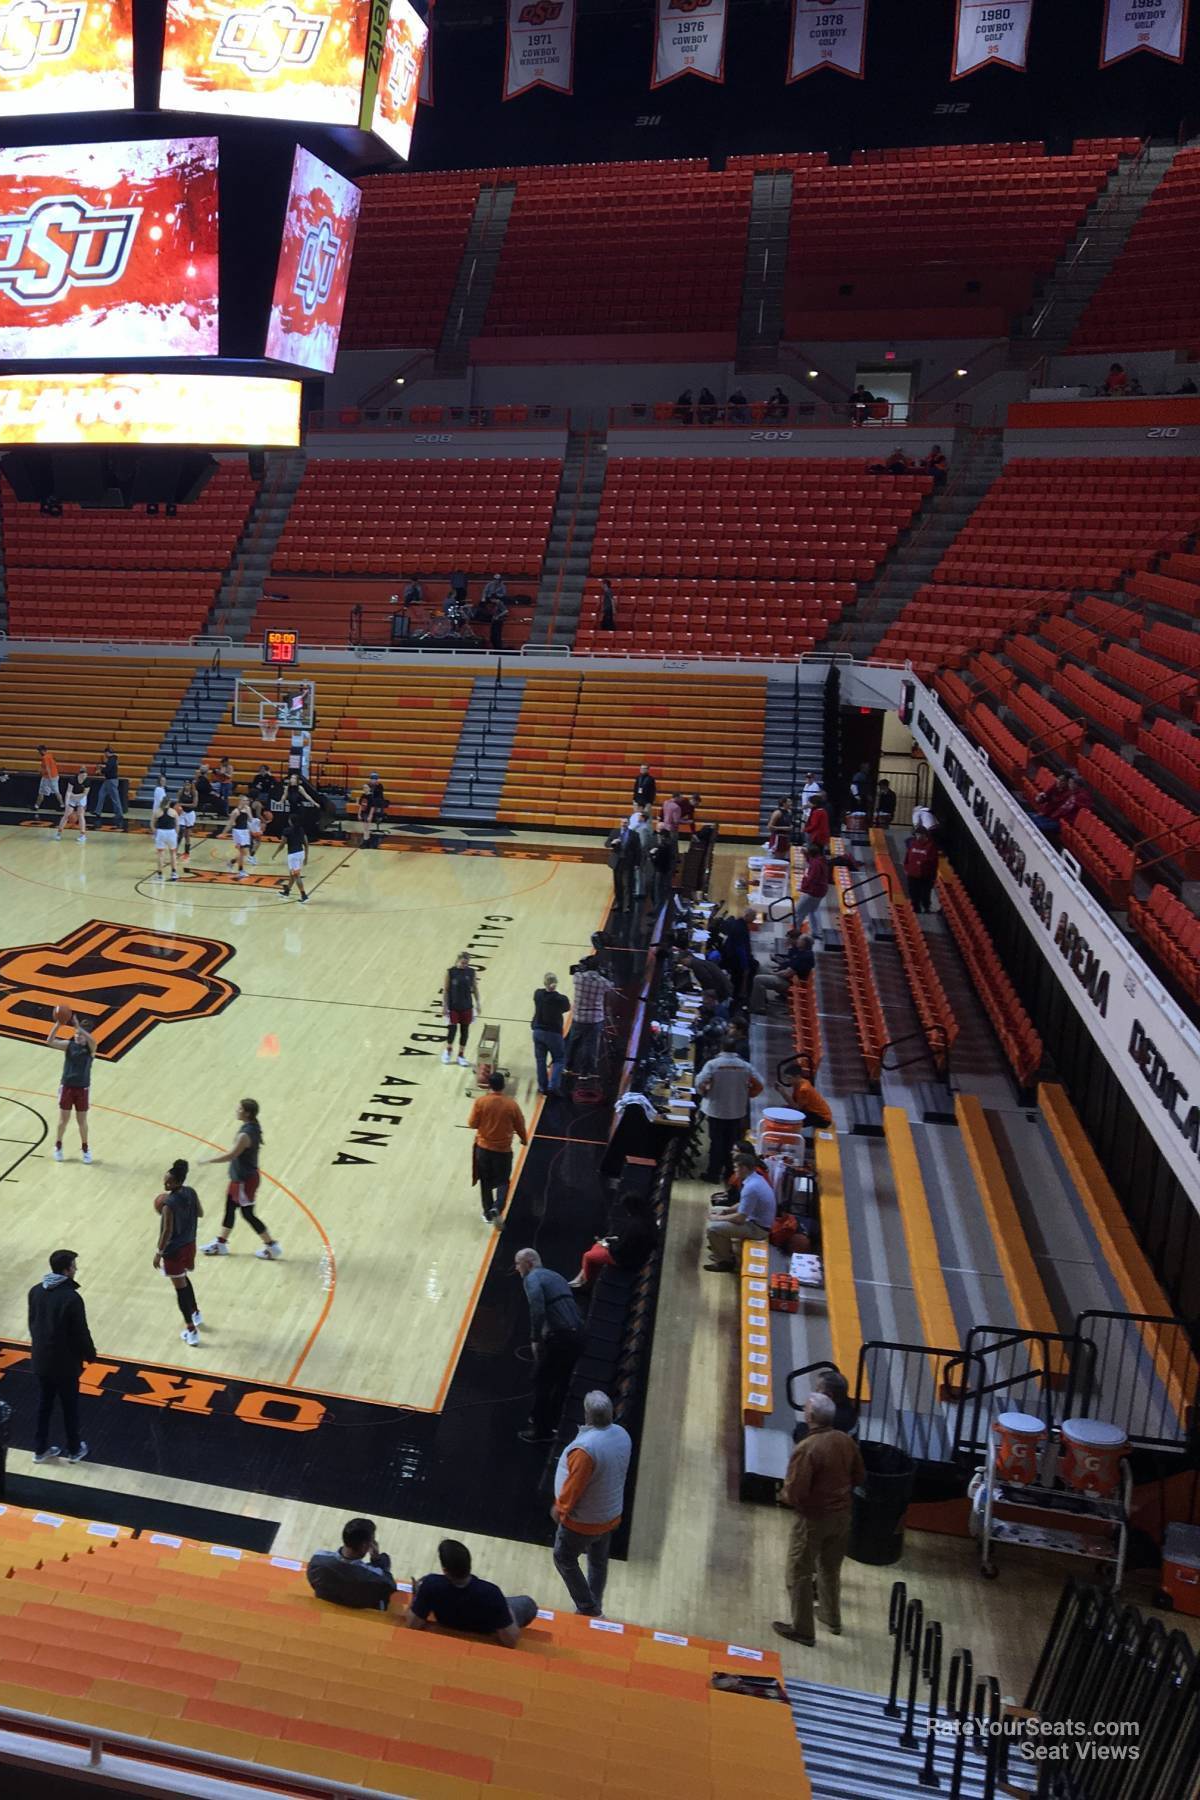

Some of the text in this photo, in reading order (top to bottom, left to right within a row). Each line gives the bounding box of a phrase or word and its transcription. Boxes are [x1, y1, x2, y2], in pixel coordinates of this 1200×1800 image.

[981, 9, 1011, 22] 1980
[1124, 10, 1166, 22] COWBOY
[677, 21, 704, 33] 1976
[975, 22, 1015, 34] COWBOY
[1134, 20, 1154, 29] GOLF
[367, 0, 390, 73] ertz
[809, 28, 848, 39] COWBOY
[984, 33, 1004, 42] GOLF
[527, 35, 553, 47] 1971
[672, 35, 708, 46] COWBOY
[818, 37, 837, 47] GOLF
[522, 48, 557, 58] COWBOY
[681, 45, 700, 54] GOLF
[519, 56, 561, 66] WRESTLING
[933, 103, 970, 114] 312
[294, 216, 341, 316] OSU
[750, 431, 793, 440] 209
[1147, 427, 1180, 438] 210
[271, 643, 293, 661] 30
[1054, 911, 1110, 1018] ARENA
[331, 1074, 422, 1165] ARENA
[1012, 1444, 1026, 1458] G
[1085, 1457, 1101, 1471] G
